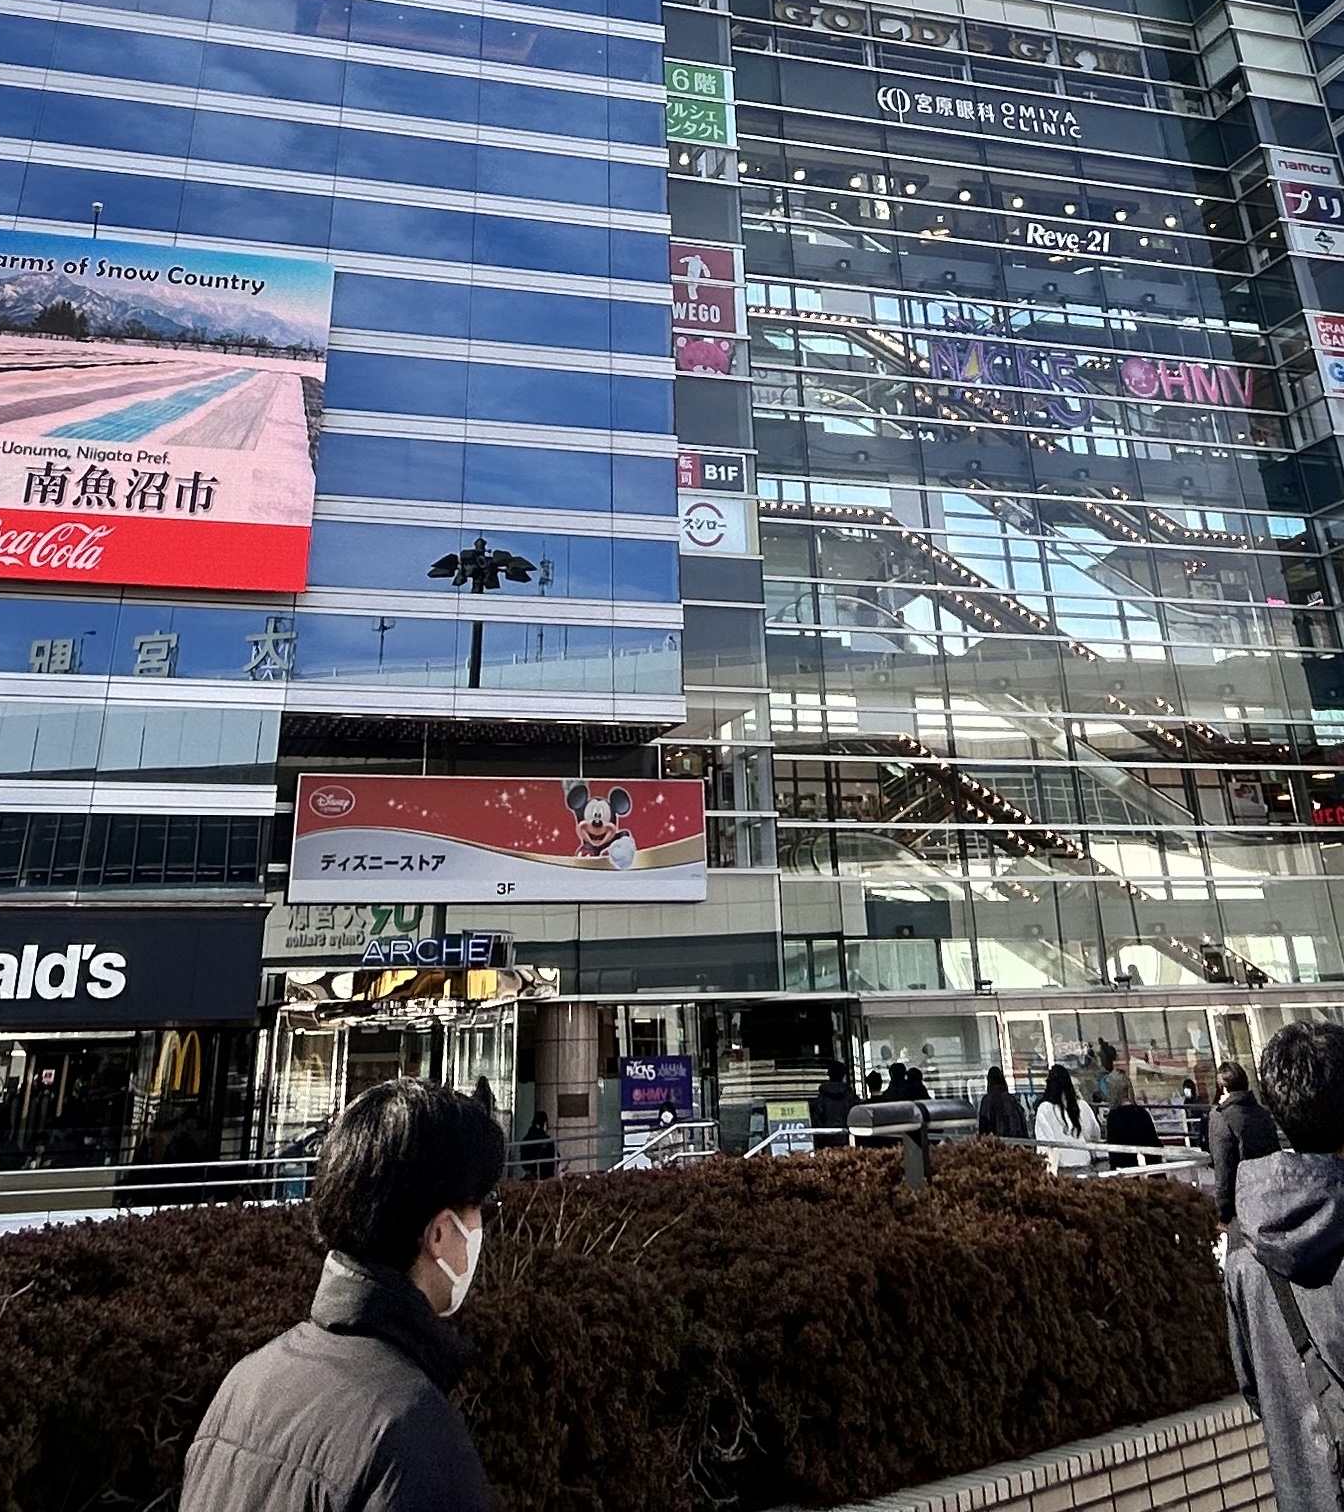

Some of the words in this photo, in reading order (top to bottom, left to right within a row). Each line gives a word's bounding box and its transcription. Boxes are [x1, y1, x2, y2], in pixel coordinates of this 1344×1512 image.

[672, 67, 717, 96] 6階
[914, 92, 996, 123] 宮原眼科
[1000, 102, 1077, 125] OMIYA
[1002, 117, 1083, 139] CLINIC
[1278, 159, 1332, 176] namco
[1285, 189, 1343, 219] プリ
[1026, 222, 1111, 253] Reve-21
[62, 256, 90, 277] of
[96, 259, 160, 285] Snow
[167, 266, 266, 296] Country
[672, 301, 722, 324] WEGO
[77, 445, 134, 465] Niigata
[138, 449, 172, 465] Pref.
[704, 464, 739, 481] B1F
[24, 461, 219, 515] 南魚沼市
[682, 517, 728, 530] スシロー
[320, 853, 446, 872] ディズニーストア
[496, 882, 516, 895] 3F
[361, 938, 491, 963] ARCHE
